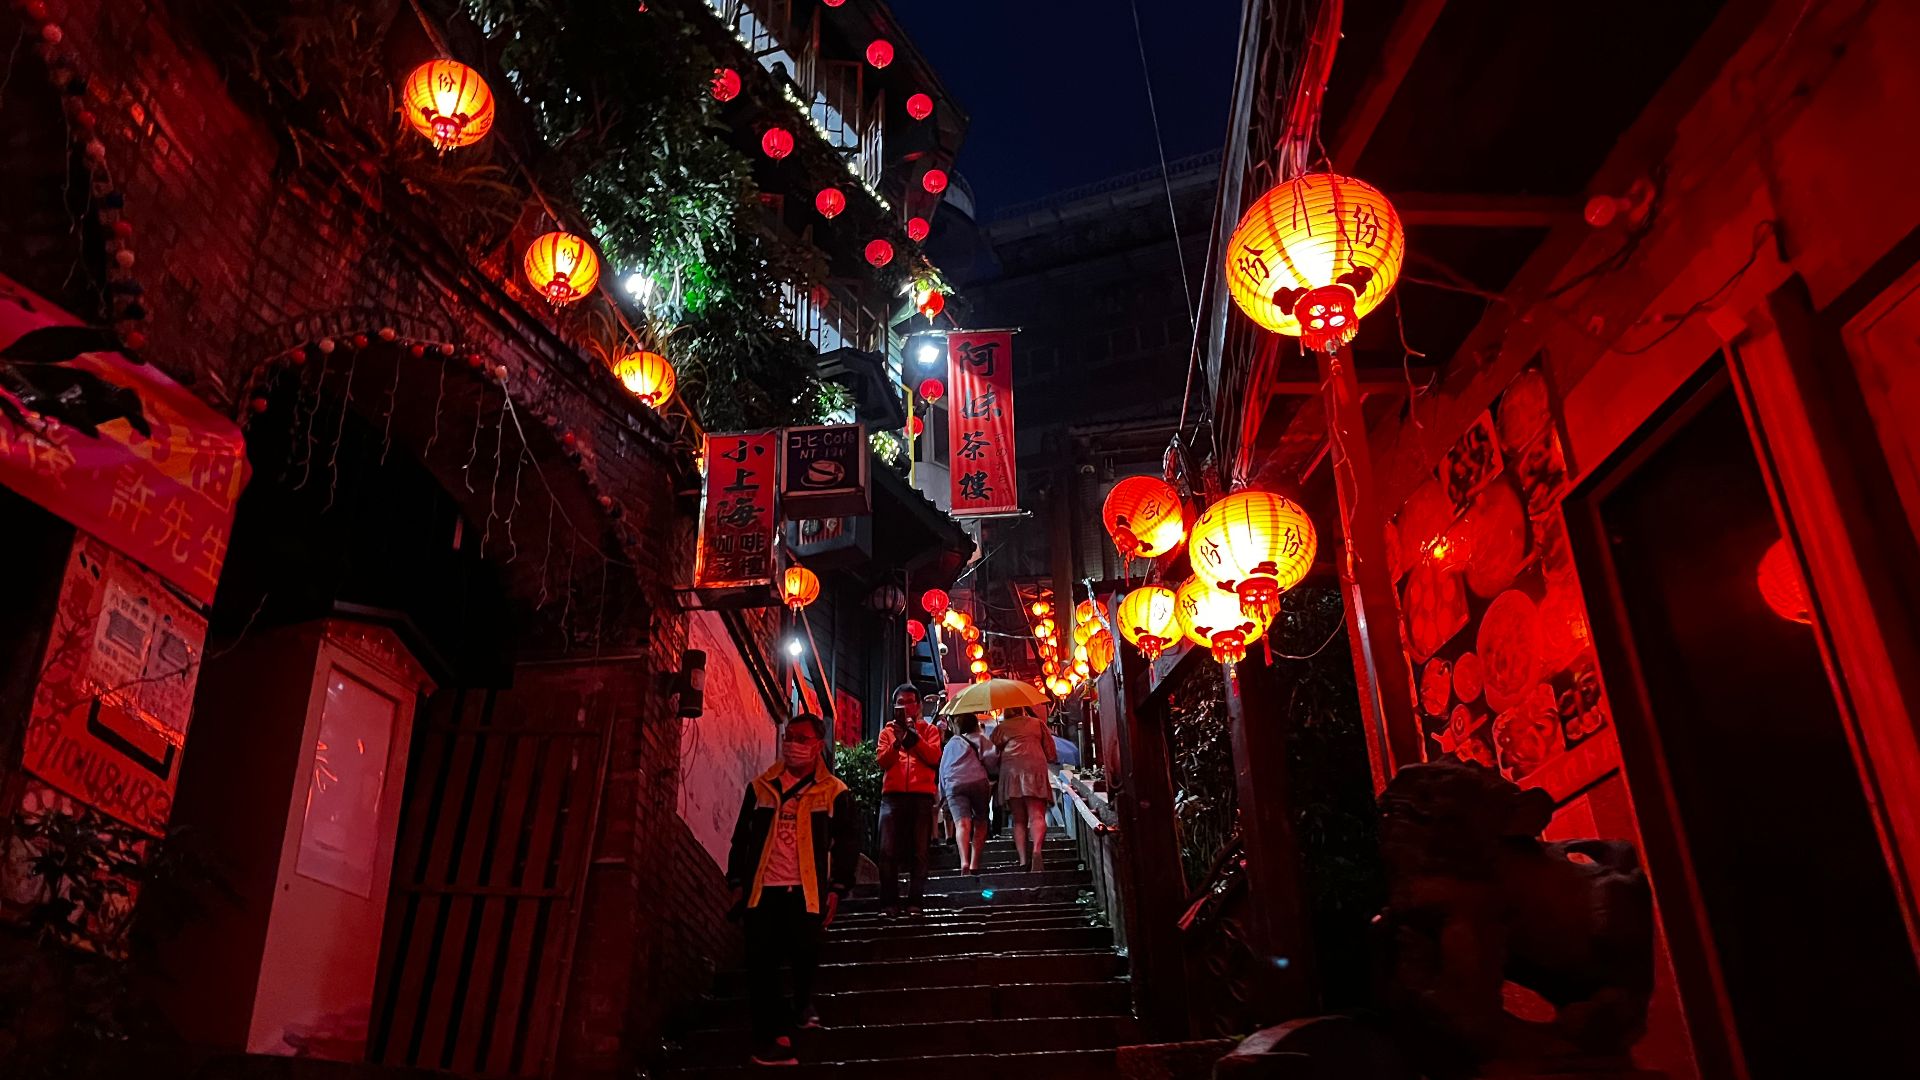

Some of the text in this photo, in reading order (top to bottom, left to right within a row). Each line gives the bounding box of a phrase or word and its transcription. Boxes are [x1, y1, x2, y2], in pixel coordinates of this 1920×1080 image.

[957, 341, 1001, 501] 阿妹茶樓
[108, 464, 228, 585] 許先生
[717, 439, 766, 529] 小上海
